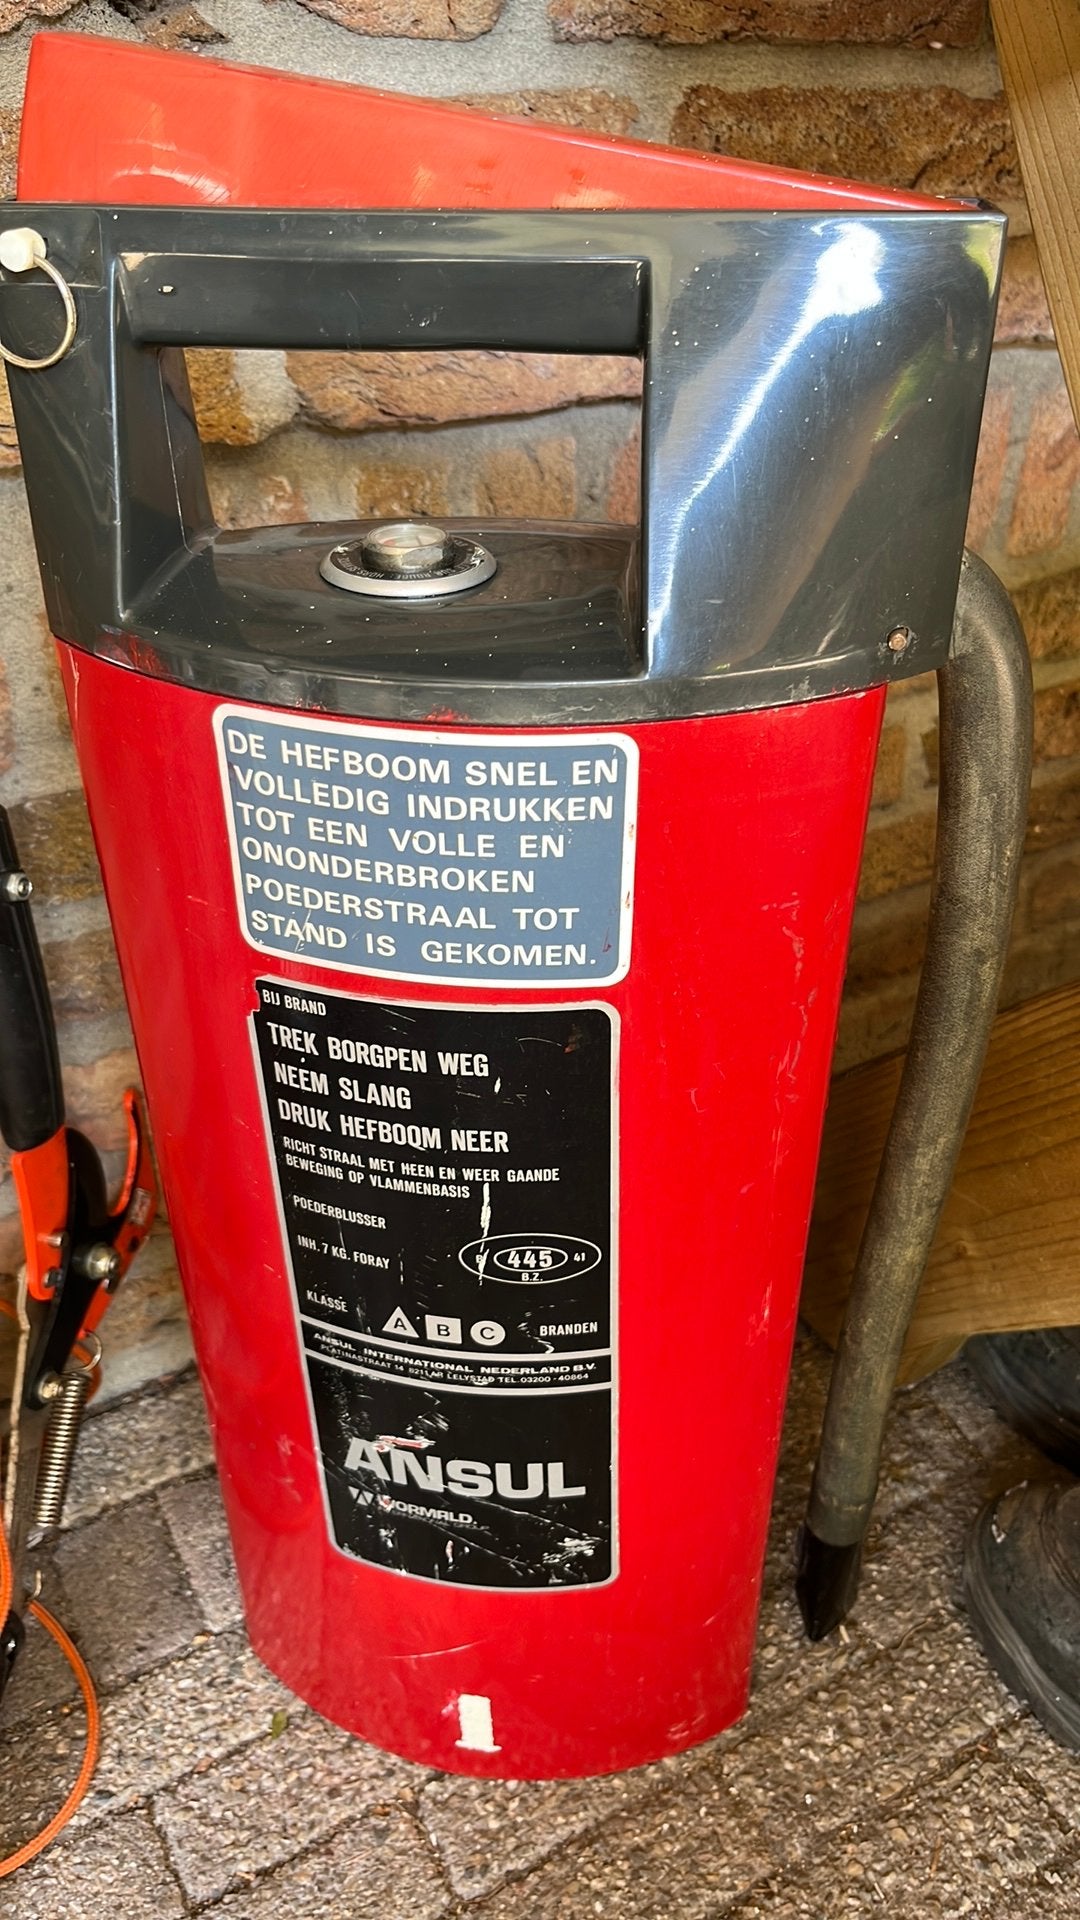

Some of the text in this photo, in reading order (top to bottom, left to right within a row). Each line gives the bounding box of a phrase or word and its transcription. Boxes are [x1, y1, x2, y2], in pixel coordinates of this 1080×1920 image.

[227, 728, 619, 787] DE HEFBOOM SNEL EN
[233, 765, 613, 822] VOLLEDIG INDRUKKEN
[236, 801, 564, 859] TOT EEN VOLLE EN
[242, 836, 535, 894] ONONDERBROKEN
[246, 872, 580, 931] POEDERSTRAAL TOT
[251, 910, 597, 967] STAND IS GEKOMEN.
[262, 989, 327, 1016] BIJ BRAND
[267, 1022, 490, 1078] TREK BORGPEN WEG
[273, 1061, 412, 1111] NEEM SLANG
[277, 1098, 510, 1154] DRUK HEFBOOM NEER
[283, 1135, 561, 1183] RICHT STRAAL MET HEEN EN WEER GAANDE
[285, 1153, 471, 1199] BEWEGING OP VLAMMENBASIS
[293, 1194, 387, 1230] POEDERBLUSSER
[297, 1234, 390, 1270] INH. 7 KG. FORAY
[507, 1249, 553, 1269] 445
[573, 1252, 586, 1262] 41
[521, 1272, 544, 1282] B.Z.
[306, 1289, 599, 1340] KLASSE A B C BRANDEN
[313, 1332, 597, 1375] ANSUL INTERNATIONAL NEDERLAND B.V.
[343, 1436, 587, 1499] ANSUL
